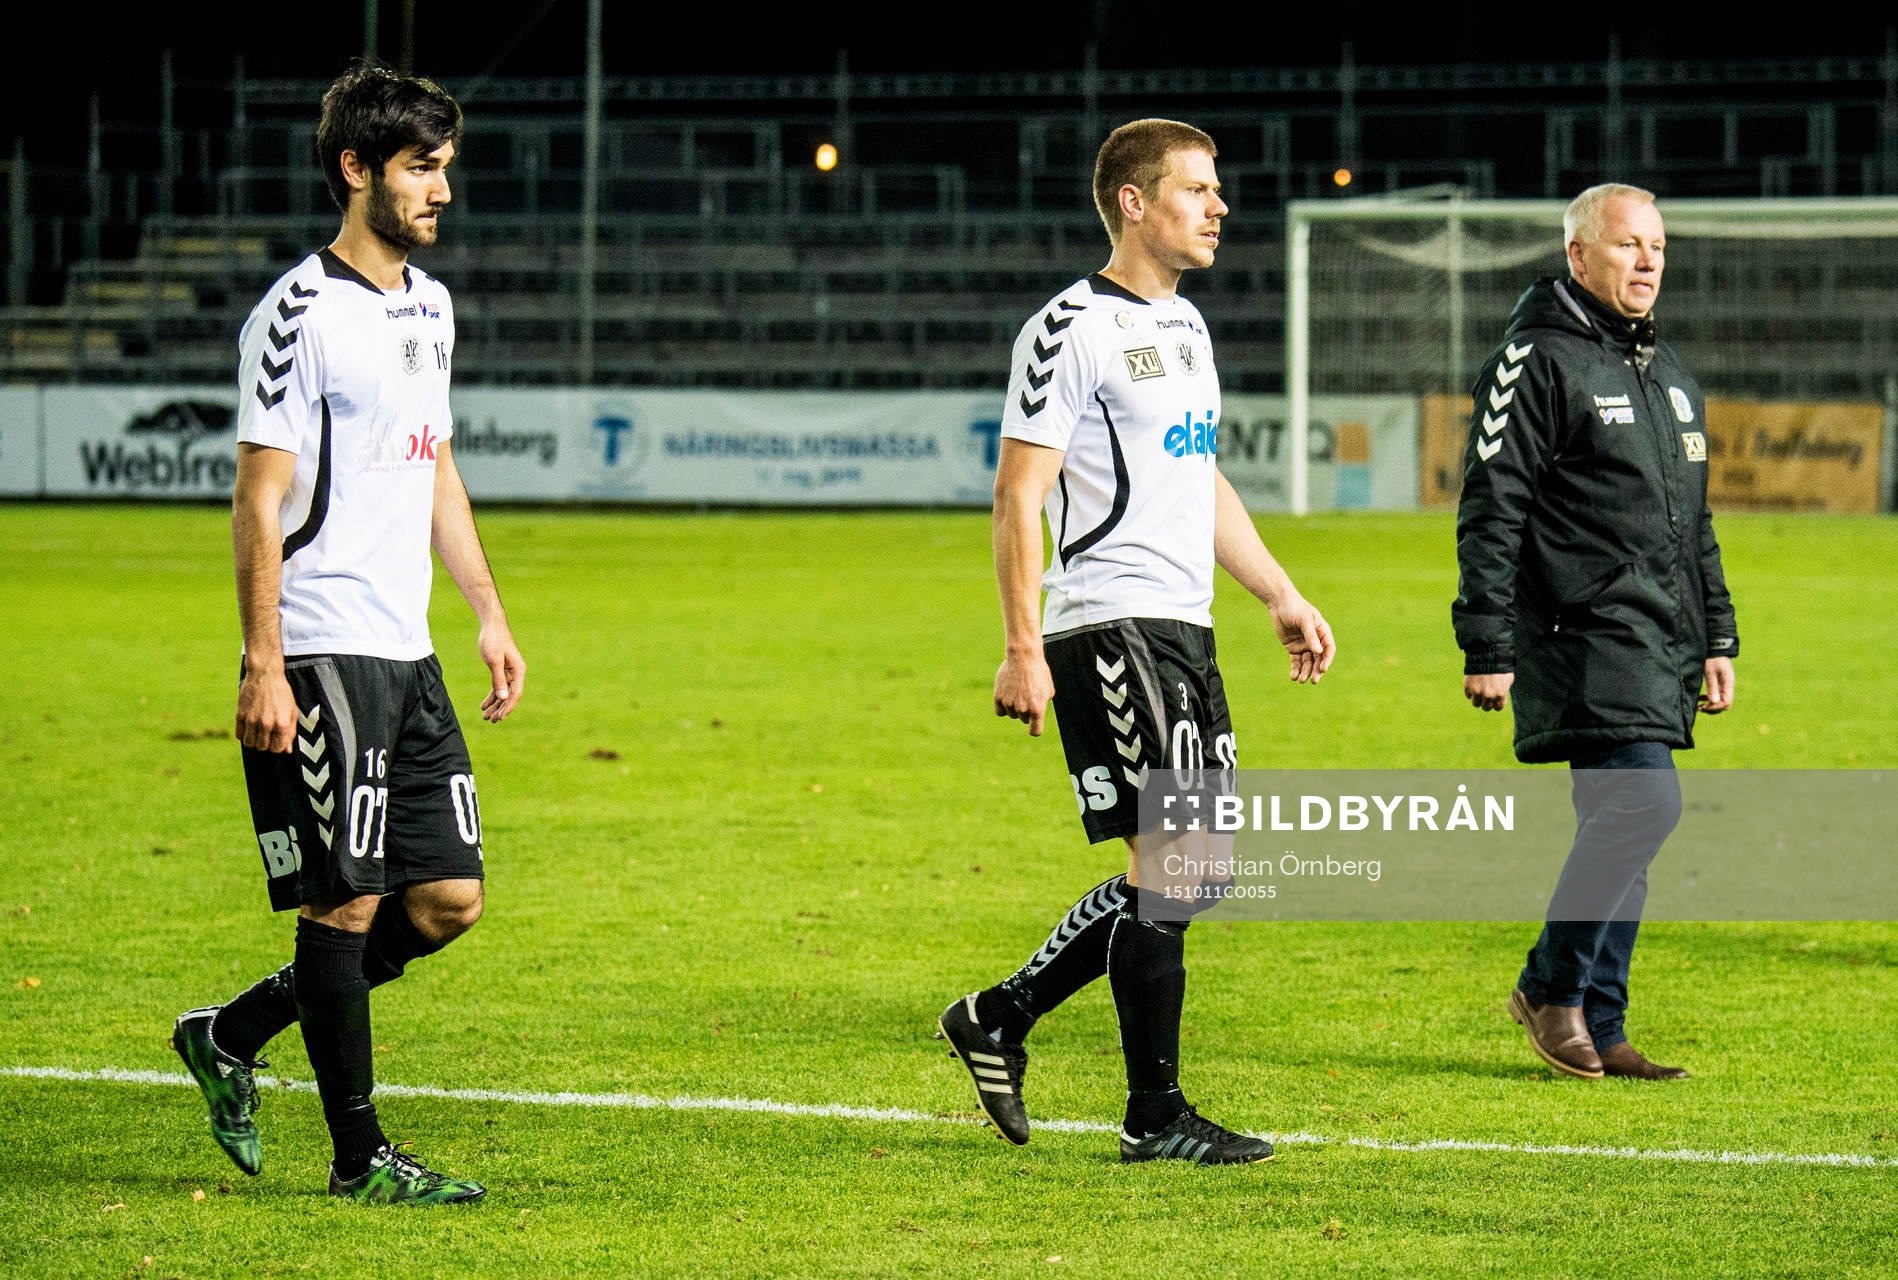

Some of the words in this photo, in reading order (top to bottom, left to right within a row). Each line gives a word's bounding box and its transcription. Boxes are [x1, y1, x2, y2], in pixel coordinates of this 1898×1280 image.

[386, 303, 418, 320] hummel
[1156, 319, 1186, 330] humme
[434, 341, 448, 370] 16
[1178, 682, 1188, 711] 3
[365, 747, 387, 779] 16
